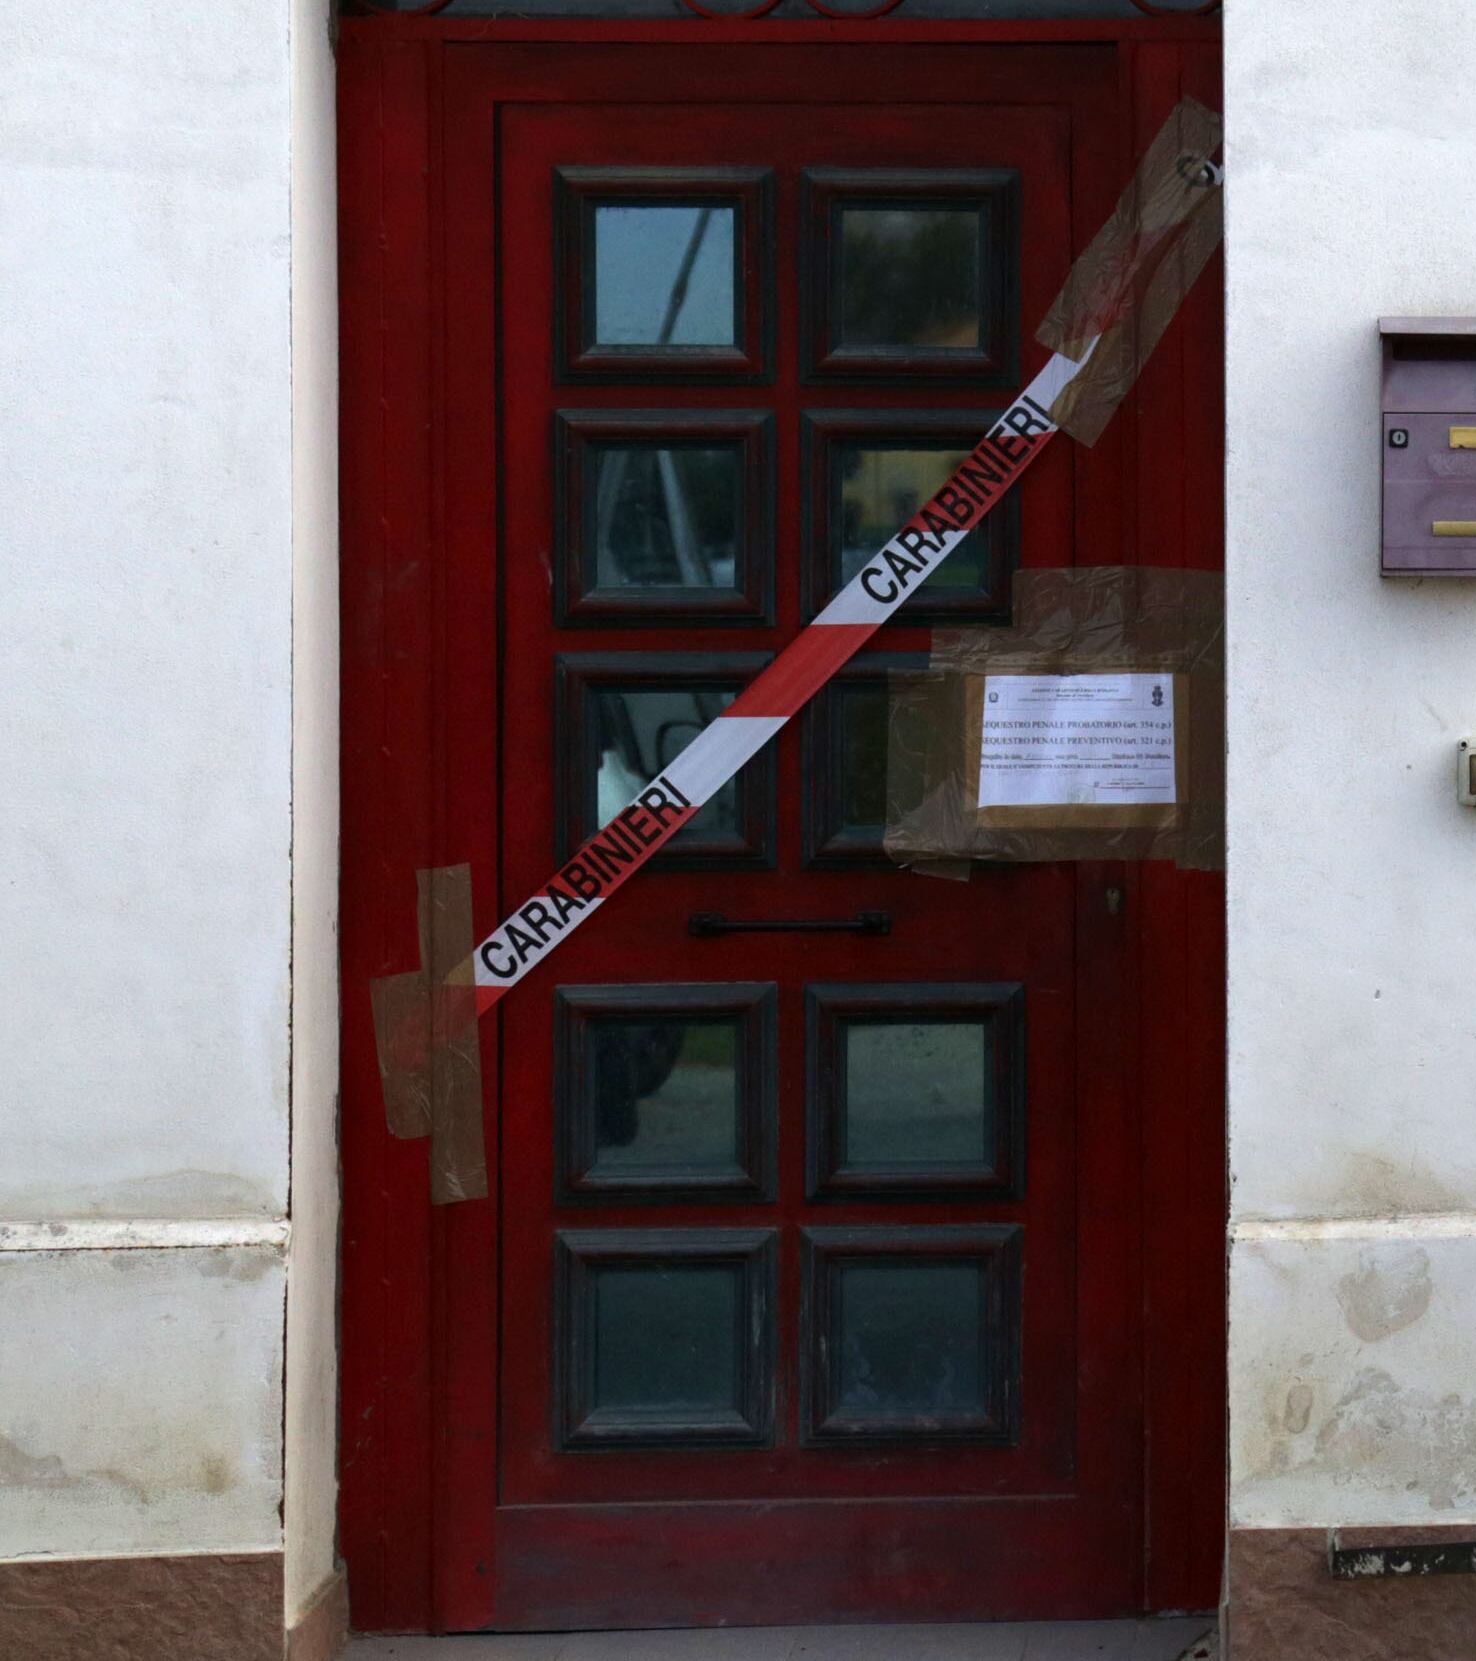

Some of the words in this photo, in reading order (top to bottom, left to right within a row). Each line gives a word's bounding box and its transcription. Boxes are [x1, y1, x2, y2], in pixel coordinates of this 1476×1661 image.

[860, 395, 1055, 605] CARABINIERI
[1032, 720, 1065, 730] PENALE
[1067, 720, 1121, 730] PROBATORIO
[1032, 736, 1065, 746] PENALE
[1067, 736, 1121, 746] PREVENTIVO
[481, 776, 691, 979] CARABINIERI
